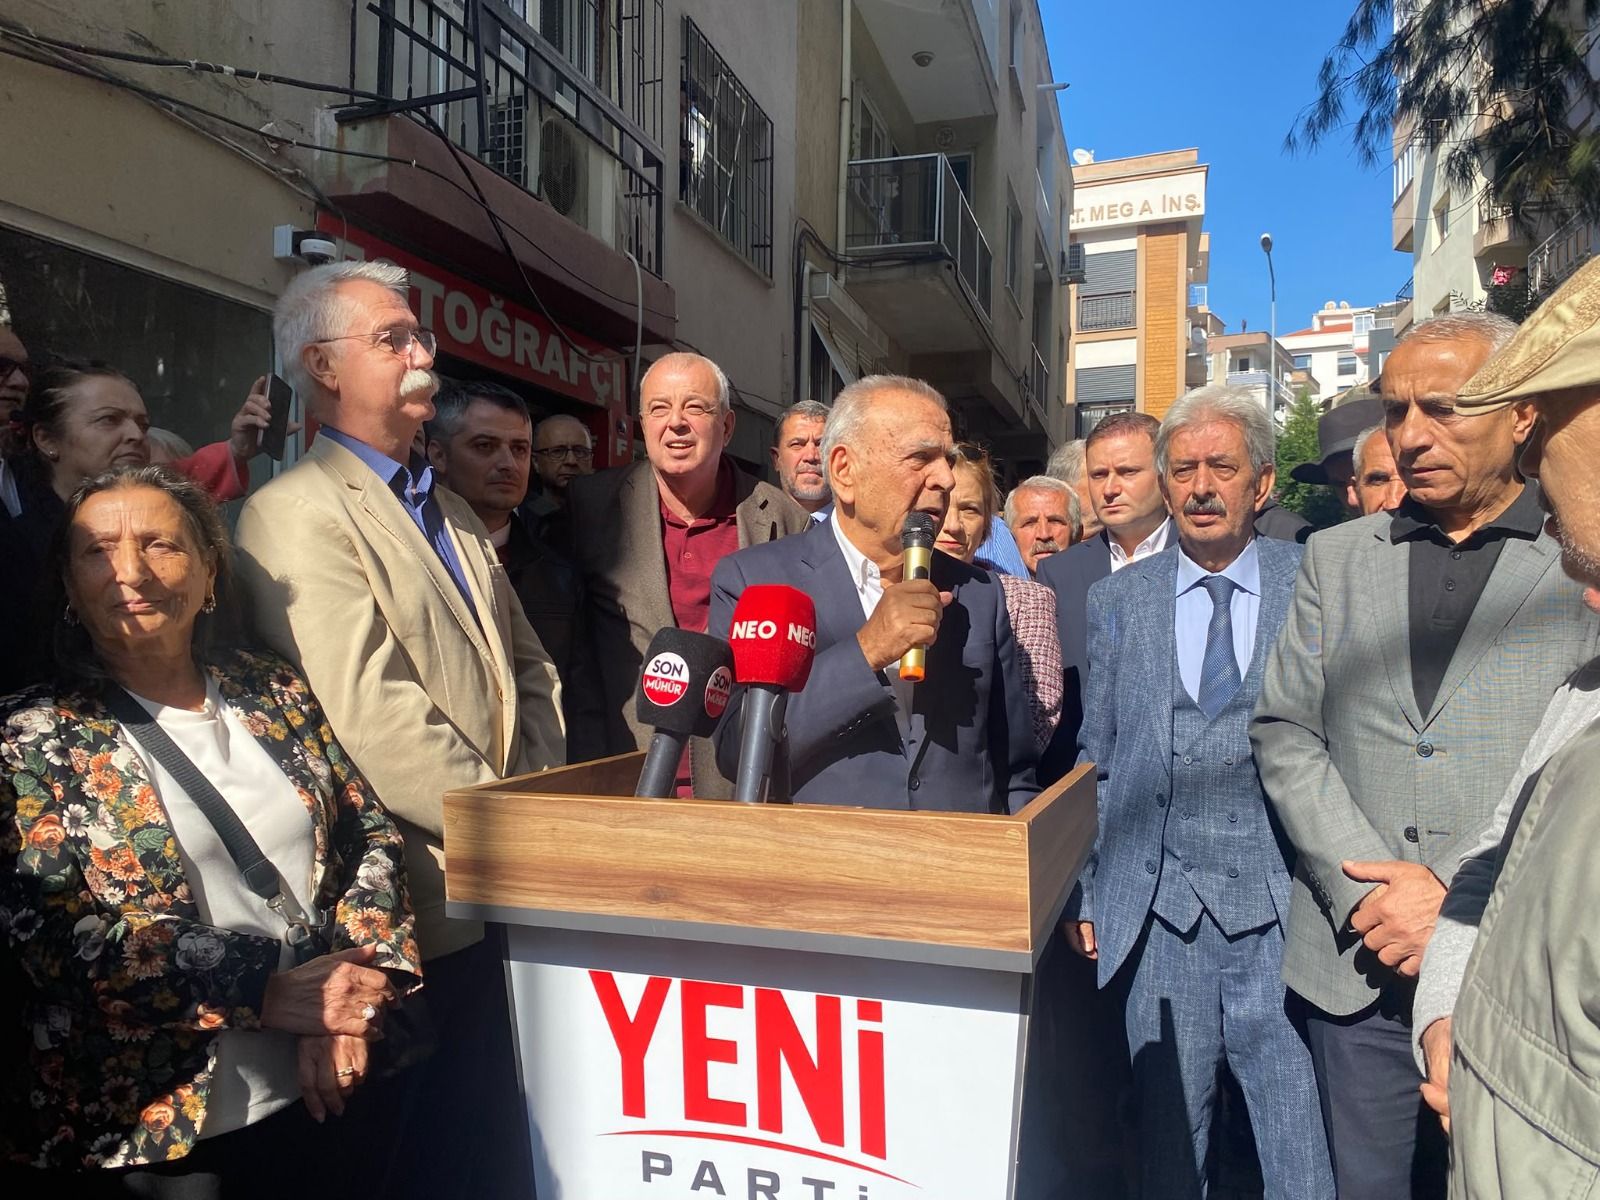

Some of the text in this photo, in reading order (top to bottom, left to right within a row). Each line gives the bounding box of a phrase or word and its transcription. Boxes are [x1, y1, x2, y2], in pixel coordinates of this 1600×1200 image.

[336, 237, 622, 405] TOĞRAFÇI
[731, 620, 777, 640] NEO
[787, 622, 816, 650] NEO
[652, 659, 684, 678] SON
[645, 678, 682, 696] MÜHÜR
[588, 970, 886, 1160] YENİ
